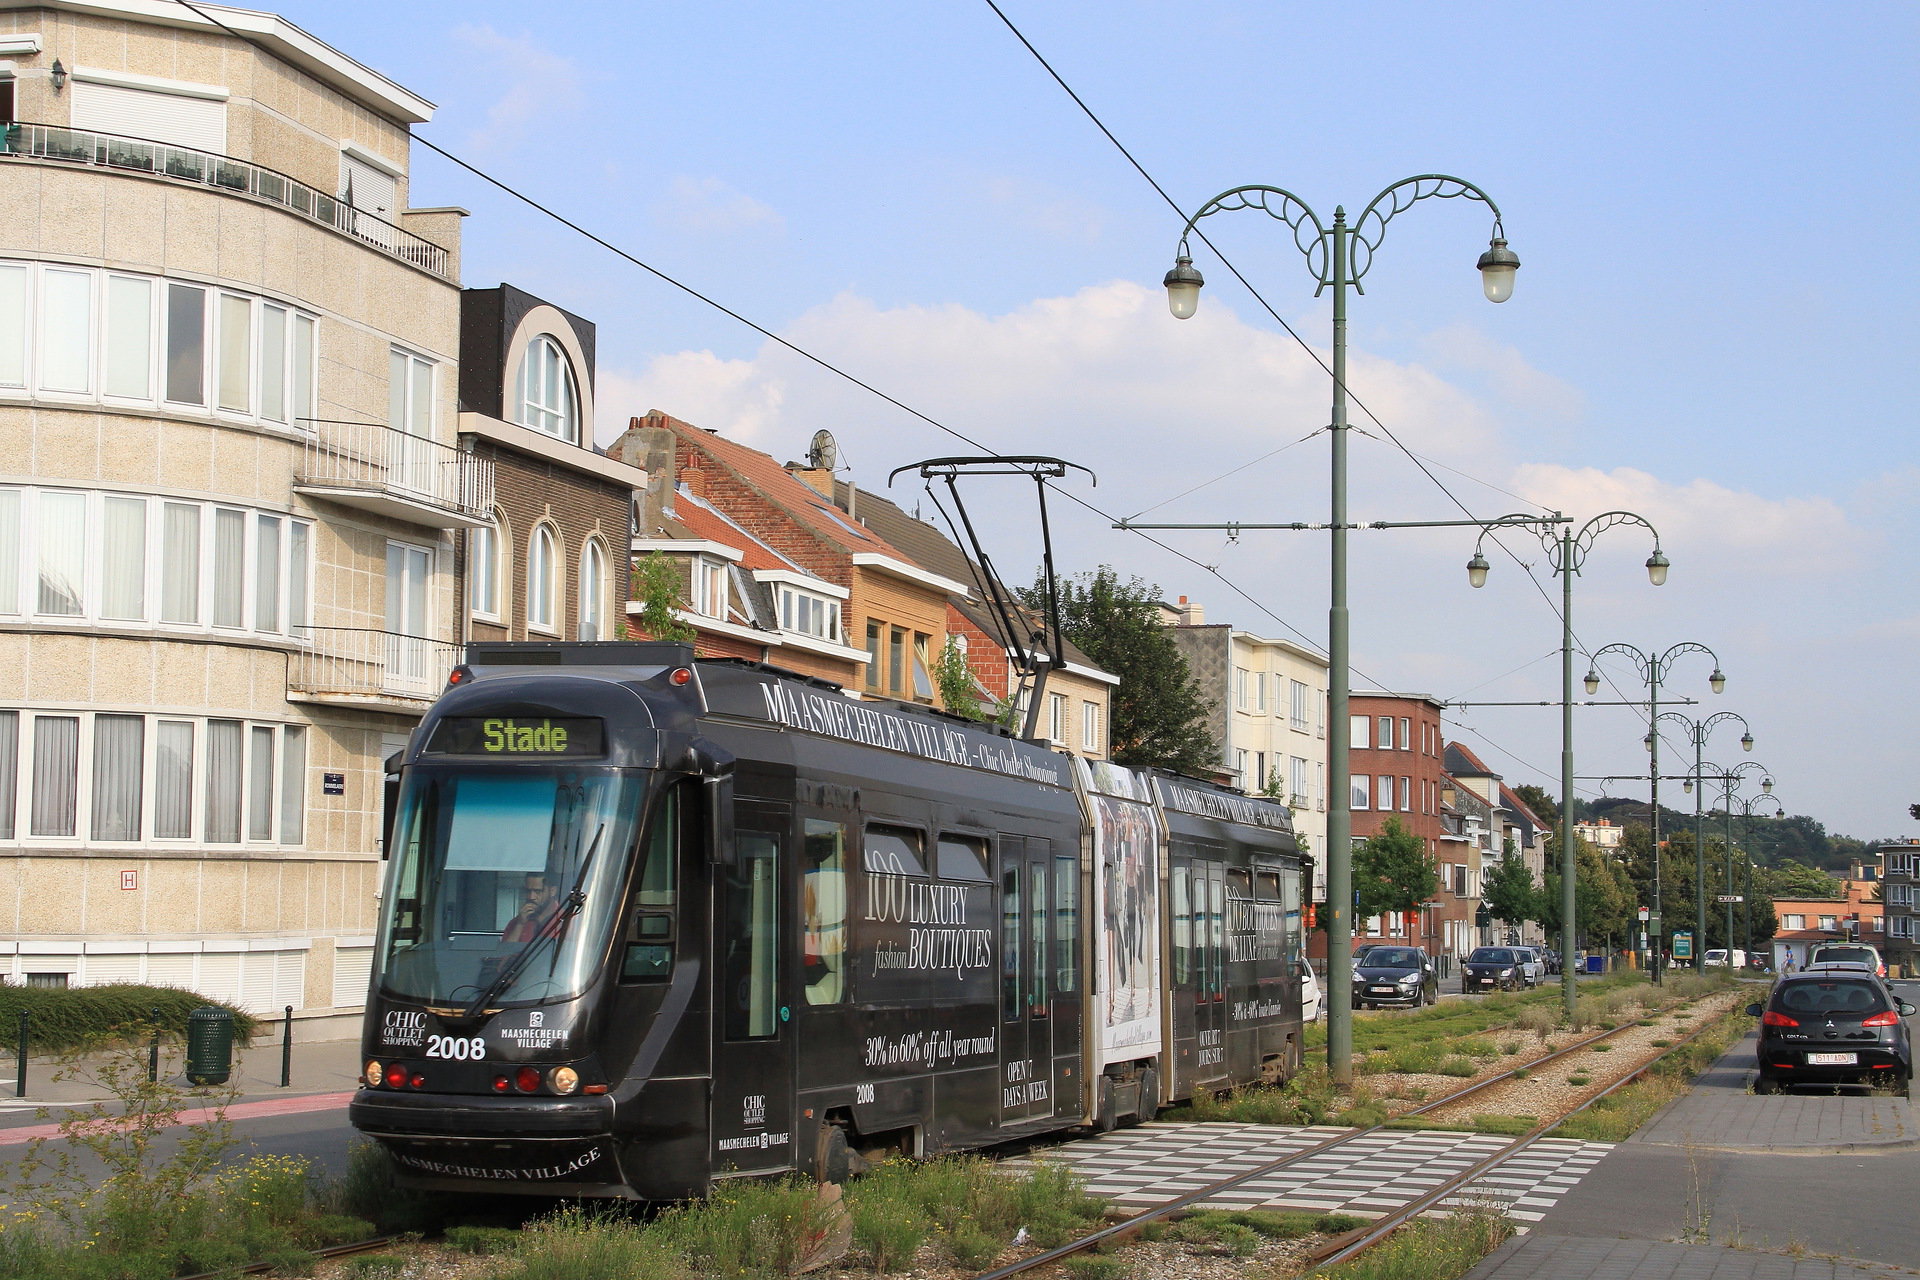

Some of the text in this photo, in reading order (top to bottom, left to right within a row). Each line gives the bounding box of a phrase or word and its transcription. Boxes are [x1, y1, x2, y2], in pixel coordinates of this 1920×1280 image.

[484, 718, 567, 752] Stade
[760, 678, 910, 752] MAASMECHELEN
[907, 720, 972, 767] VILLAGE
[979, 743, 999, 772] Chic
[1000, 738, 1025, 777] Outlet
[1169, 784, 1231, 821] MAASMECHELEN
[864, 849, 968, 925] 100 LUXURY
[1242, 904, 1278, 938] BOUTIQUES
[872, 928, 992, 981] fashion BOUTIQUES
[1239, 935, 1257, 962] LUXE
[383, 1026, 425, 1039] OUTLET
[385, 1010, 427, 1029] CHIC
[382, 1036, 423, 1047] SHOPPING
[426, 1034, 486, 1060] 2008
[501, 1028, 569, 1040] MAASMECHELEN
[517, 1038, 552, 1049] VILLAGE
[865, 1035, 887, 1066] 30%
[888, 1040, 898, 1064] to
[923, 1030, 940, 1067] off
[939, 1029, 952, 1058] all
[952, 1037, 970, 1065] year
[971, 1026, 995, 1055] round
[1007, 1059, 1033, 1082] OPEN 7
[743, 1094, 766, 1109] CHIC
[856, 1083, 875, 1104] 2008
[1003, 1079, 1048, 1108] DAYS A WEEK
[743, 1108, 765, 1118] OUTLET
[718, 1132, 789, 1151] MAASMECHELEN VILLAGE
[522, 1146, 601, 1180] VILLAGE
